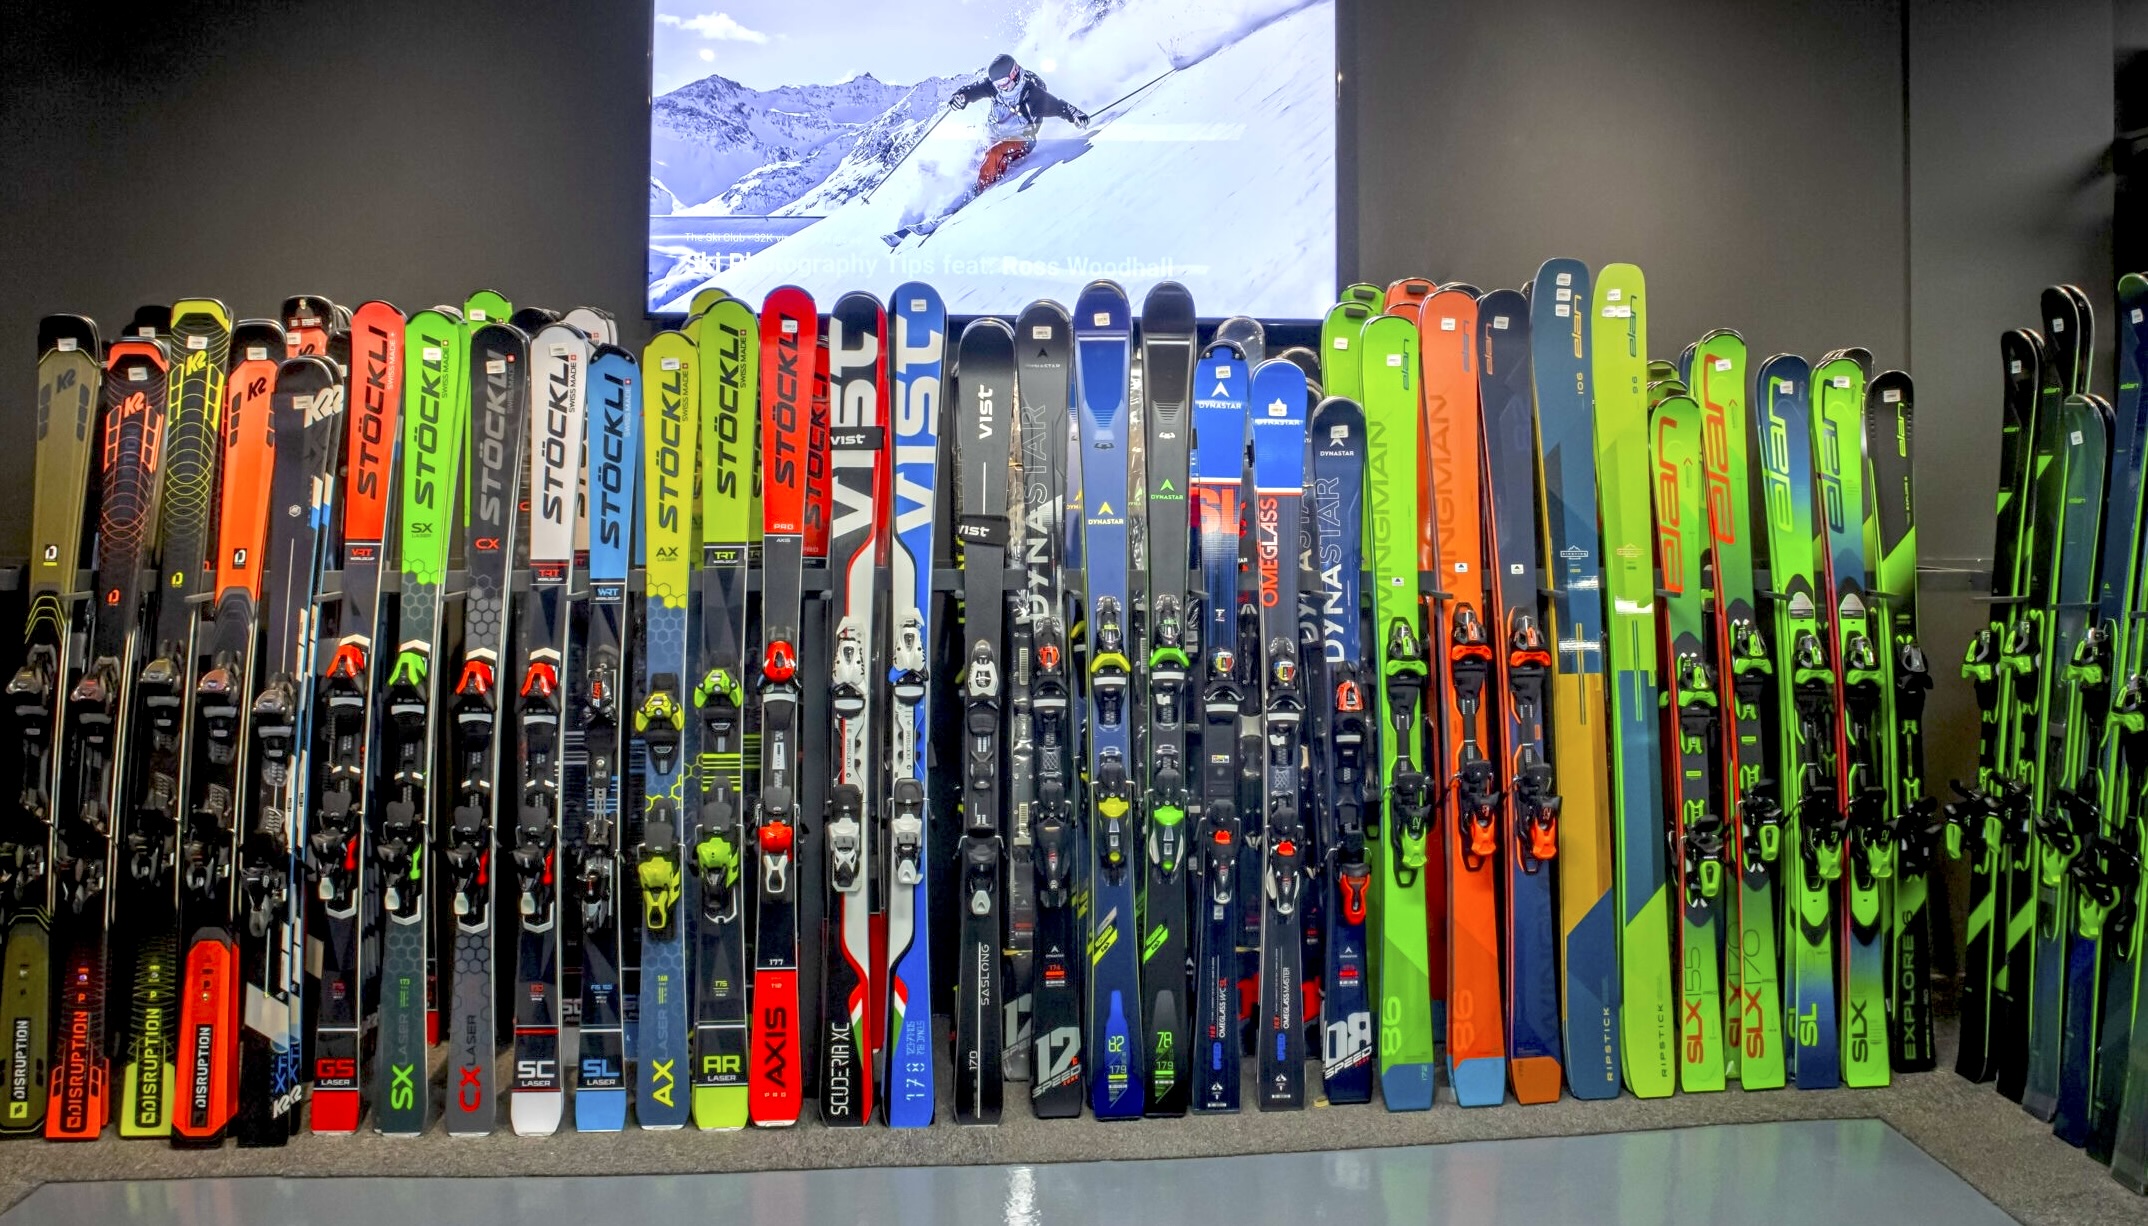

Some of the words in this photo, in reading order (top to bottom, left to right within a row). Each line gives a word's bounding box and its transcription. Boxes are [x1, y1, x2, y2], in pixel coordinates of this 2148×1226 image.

[685, 232, 702, 242] The
[706, 232, 721, 242] Ski
[724, 232, 745, 242] Club
[686, 252, 721, 273] Ski
[888, 253, 935, 279] Tips
[1002, 256, 1060, 276] Ross
[1067, 255, 1174, 277] Woodhall
[56, 369, 76, 394] K2
[186, 350, 207, 376] K2
[387, 366, 395, 390] SWISS
[124, 392, 145, 418] K2
[248, 376, 267, 401] K2
[714, 323, 740, 499] STÖCKLI
[1199, 402, 1242, 410] DYNASTAR
[357, 325, 388, 500] STÖCKLI
[598, 373, 624, 549] STÖCKLI
[656, 362, 681, 533] STÖCKL
[411, 522, 433, 534] SX
[1200, 488, 1239, 535] SL
[1366, 420, 1394, 624] WINGMAN
[475, 538, 500, 550] CX
[656, 547, 678, 557] AX
[715, 552, 736, 560] TRT
[1262, 497, 1278, 608] OMEGLASS
[1317, 477, 1345, 663] DYNASTAR
[981, 944, 990, 1006] SASLONG
[1282, 967, 1290, 993] MASTER
[1453, 990, 1475, 1050] 86
[1904, 937, 1917, 1060] EXPLORE
[467, 1014, 477, 1066] LASER
[831, 1022, 849, 1043] XC
[1108, 1035, 1125, 1053] 82
[1157, 1031, 1172, 1048] 78
[1382, 996, 1401, 1056] 86
[1603, 1007, 1614, 1081] RIPSTICK
[1658, 1004, 1668, 1077] RIPSTICK
[1686, 1000, 1704, 1064] SLX
[1744, 986, 1764, 1058] SLX
[1800, 1003, 1818, 1047] SL
[1851, 1000, 1868, 1063] SLX
[13, 1020, 29, 1100] DISRUPTION
[67, 1011, 88, 1115] DISRUPTION
[141, 1008, 161, 1112] DISRUPTION
[194, 1026, 211, 1109] DISRUPTION
[317, 1059, 354, 1077] GS
[518, 1060, 555, 1078] SC
[582, 1059, 619, 1078] SL
[703, 1055, 740, 1074] AR
[765, 1006, 787, 1088] AXIS
[1035, 1026, 1081, 1085] 12
[1109, 1065, 1127, 1074] 179
[1156, 1061, 1174, 1070] 179
[1325, 1046, 1372, 1080] SPEED
[391, 1064, 413, 1110] SX
[459, 1066, 481, 1112] CX
[652, 1058, 674, 1108] AX
[830, 1045, 849, 1116] SCUDERIA
[1032, 1063, 1082, 1099] SPEED
